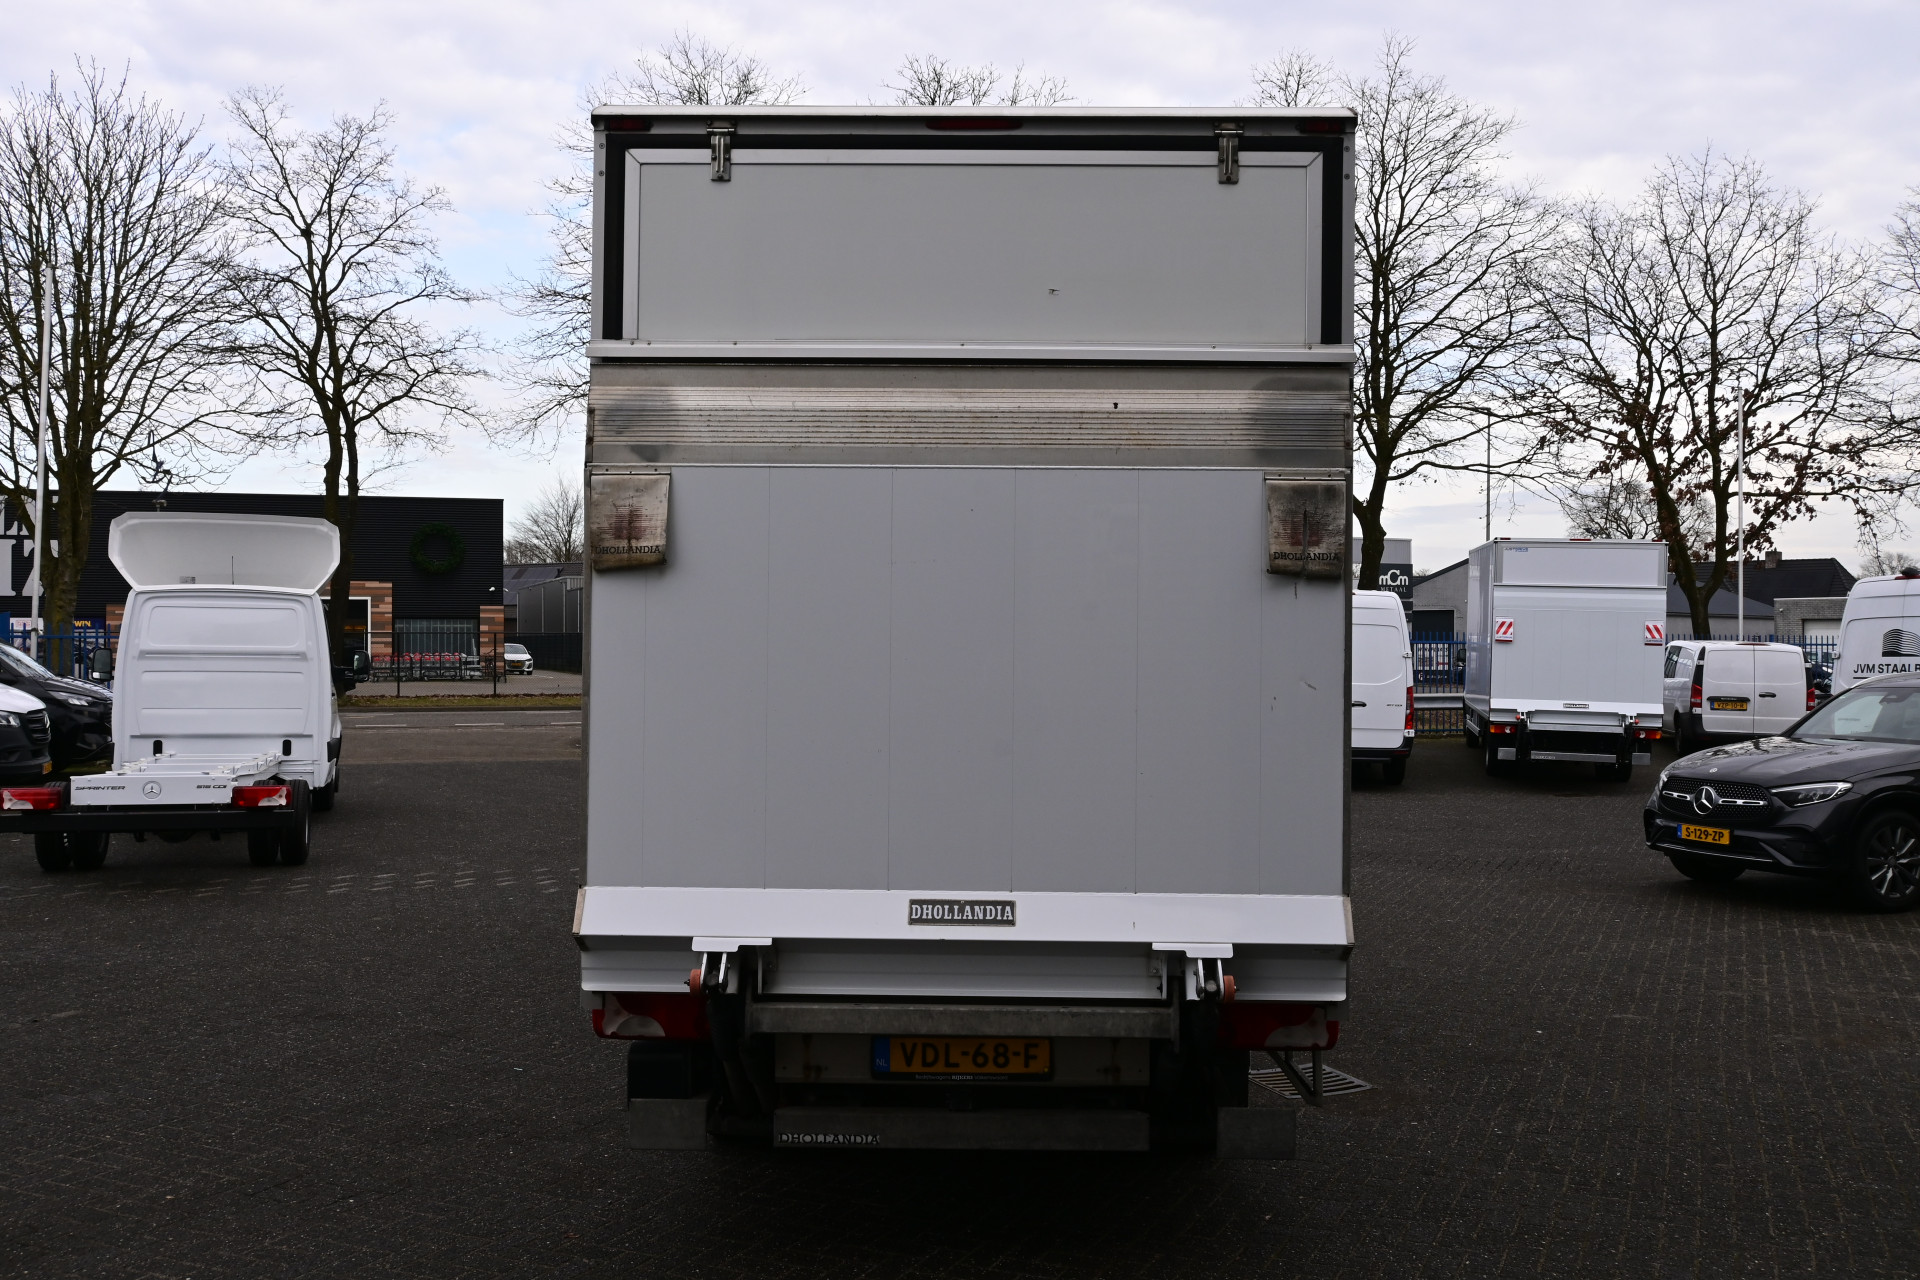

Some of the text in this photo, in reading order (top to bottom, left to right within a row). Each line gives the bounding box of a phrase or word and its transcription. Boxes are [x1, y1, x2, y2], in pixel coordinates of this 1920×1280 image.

[596, 546, 661, 555] DHOLLANDIA
[1273, 551, 1340, 561] DHOLLANDIA
[1853, 663, 1875, 674] JVM
[1685, 826, 1725, 842] S-129-ZP
[910, 904, 1014, 920] DHOLLANDIA
[900, 1042, 1040, 1069] VDL-68-F
[875, 1058, 888, 1067] NL
[778, 1133, 880, 1145] DHOLLANDIA
